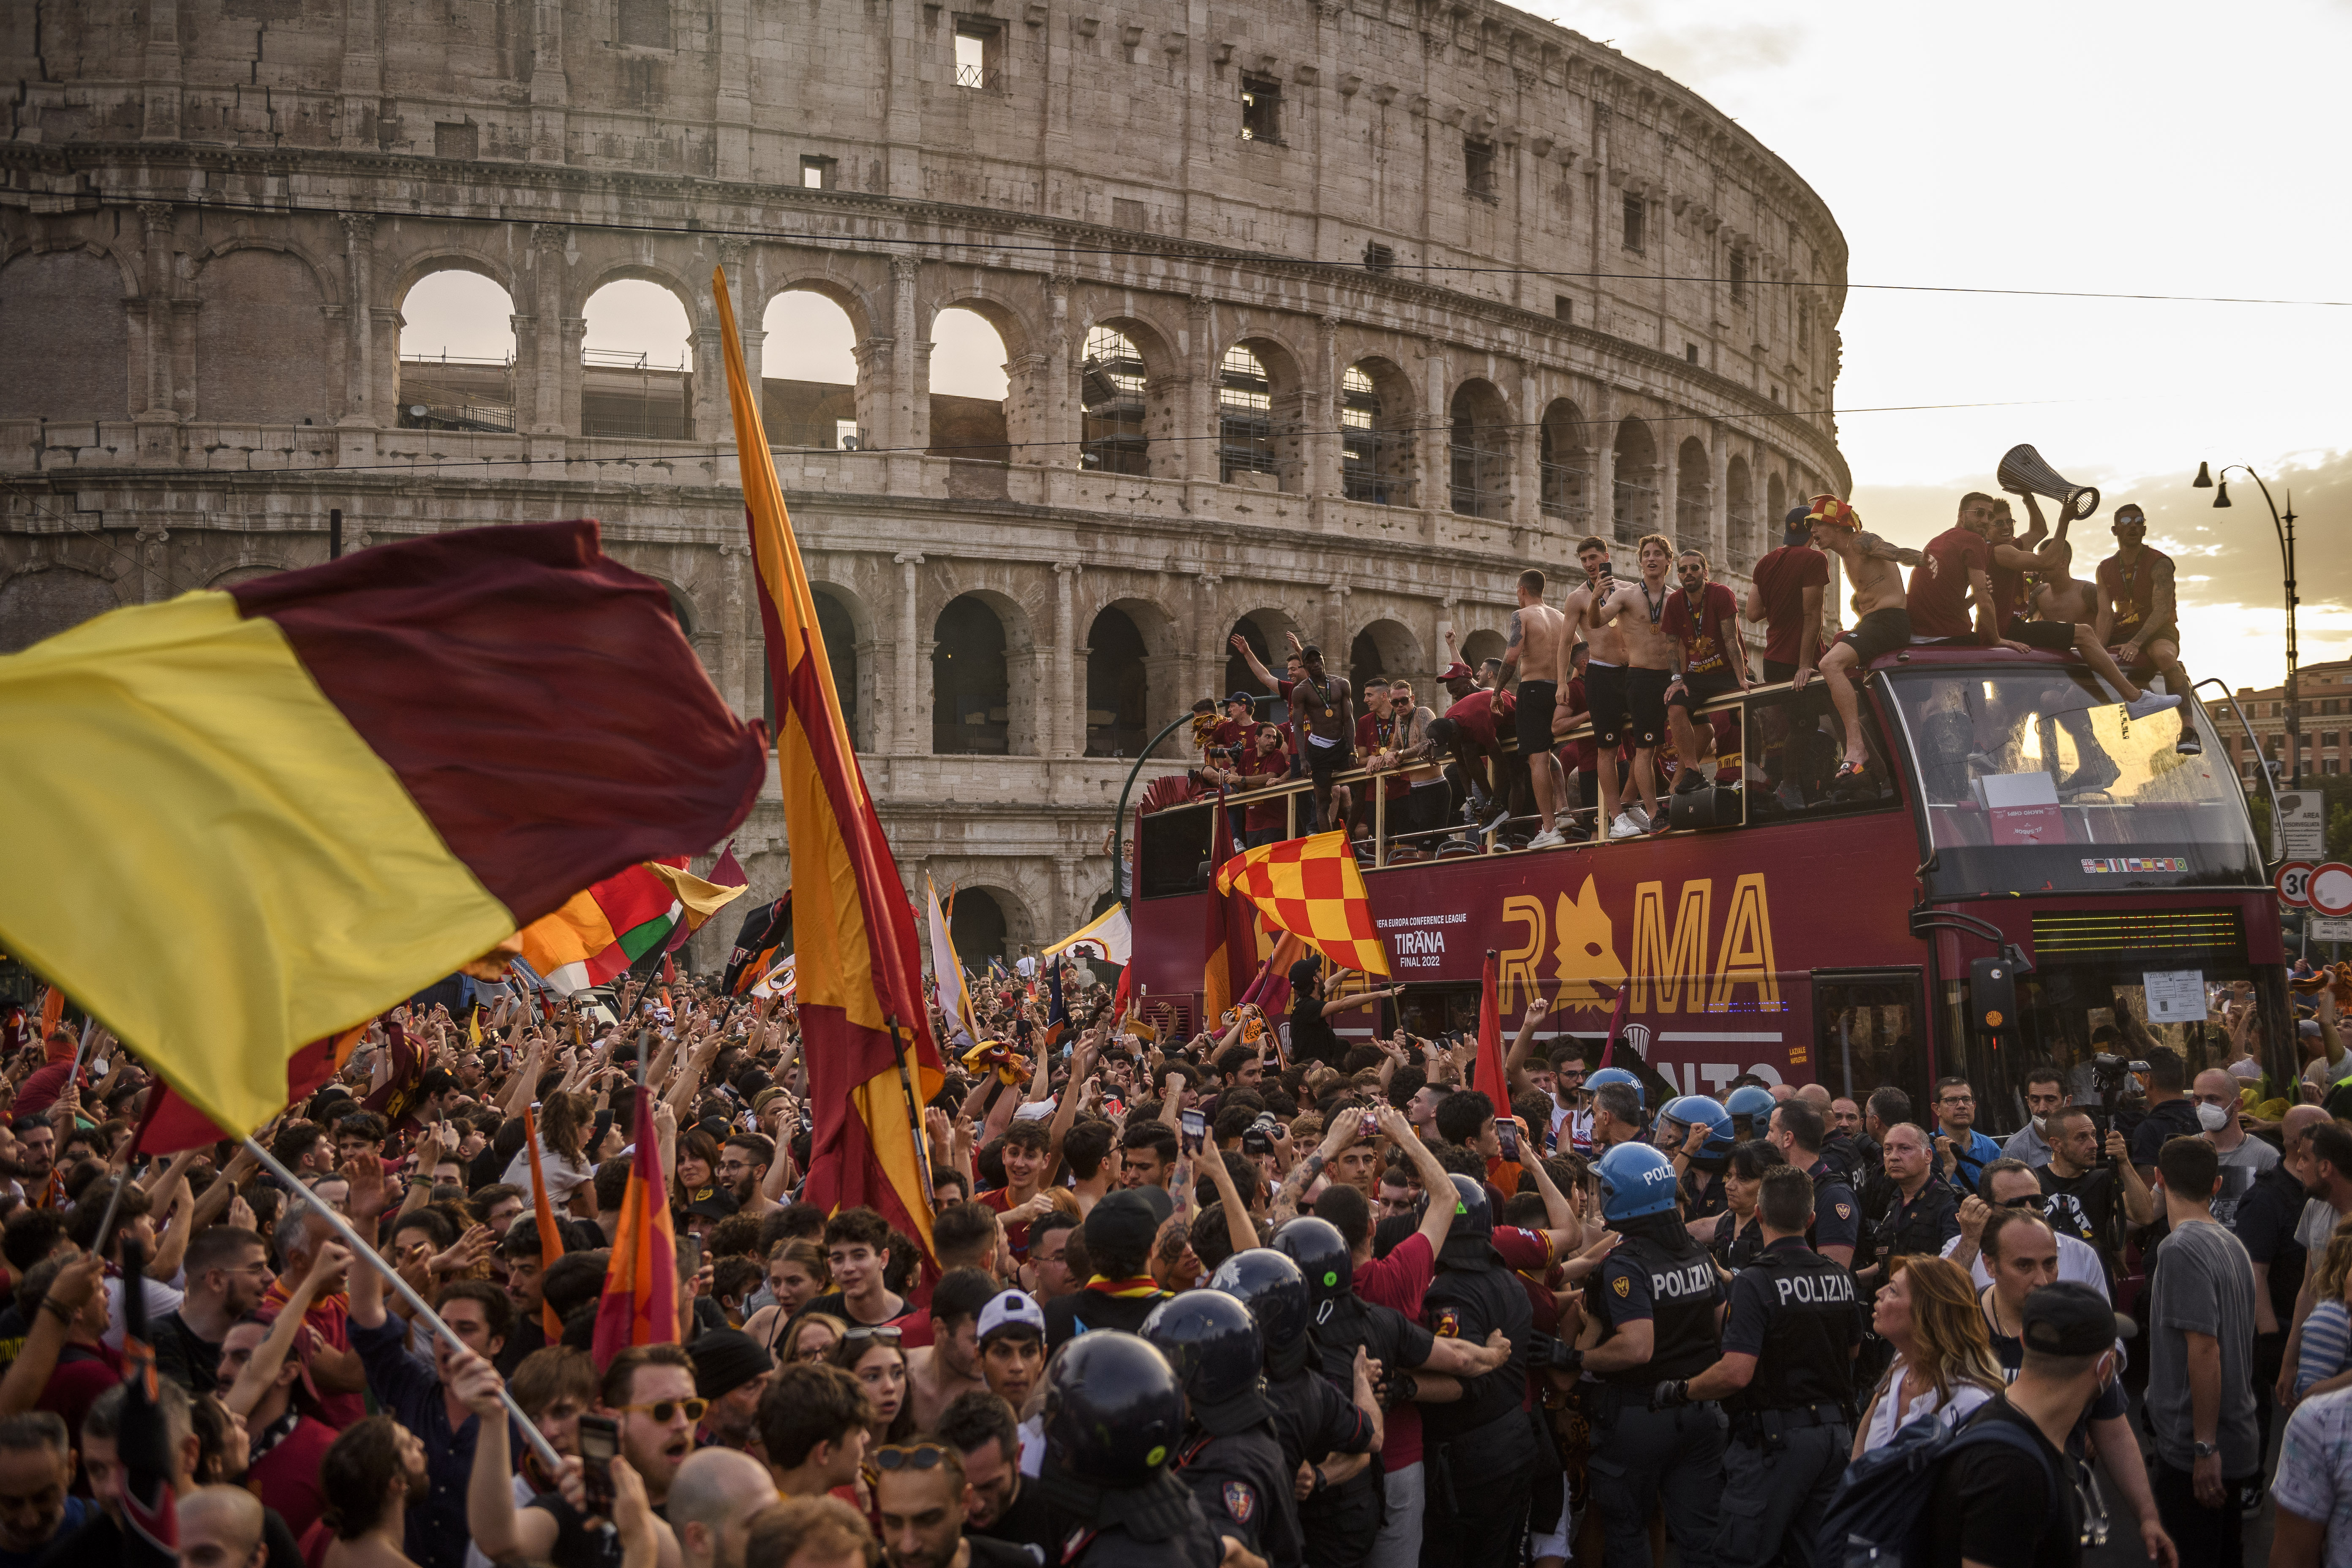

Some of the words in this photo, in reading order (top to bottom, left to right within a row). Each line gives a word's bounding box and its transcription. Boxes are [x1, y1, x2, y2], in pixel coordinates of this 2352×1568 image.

[1388, 917, 1409, 928] EUROPA
[1410, 915, 1444, 926] CONFERENCE
[1445, 913, 1467, 924] LEAGUE
[1400, 957, 1421, 967] FINAL
[1422, 956, 1440, 966] 2022
[1789, 1046, 1806, 1056] LAZIALE
[1652, 1262, 1715, 1300] POLIZIA
[1775, 1275, 1854, 1306] POLIZIA
